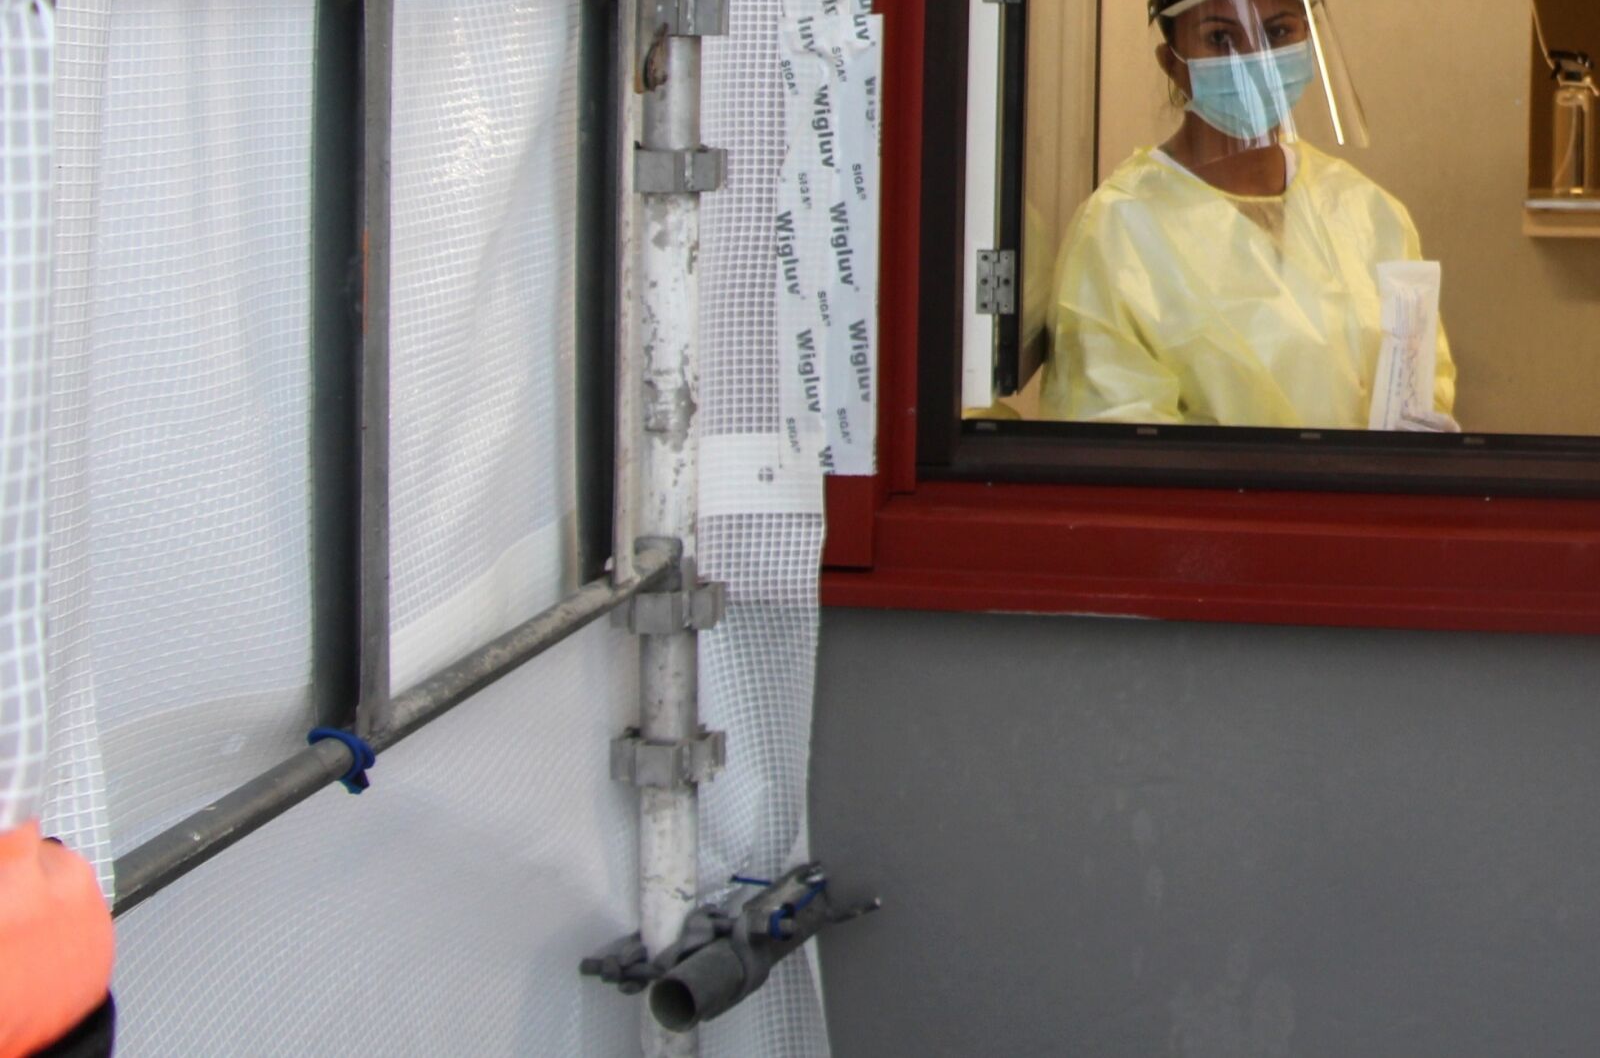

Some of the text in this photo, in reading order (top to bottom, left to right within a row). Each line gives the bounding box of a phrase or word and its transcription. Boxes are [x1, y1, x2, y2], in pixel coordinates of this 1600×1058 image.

[812, 84, 835, 168] Wigluv
[776, 210, 800, 295] Wigluv
[829, 202, 854, 286] Wigluv
[796, 328, 821, 413] Wigluv
[849, 318, 870, 403] Wigluv
